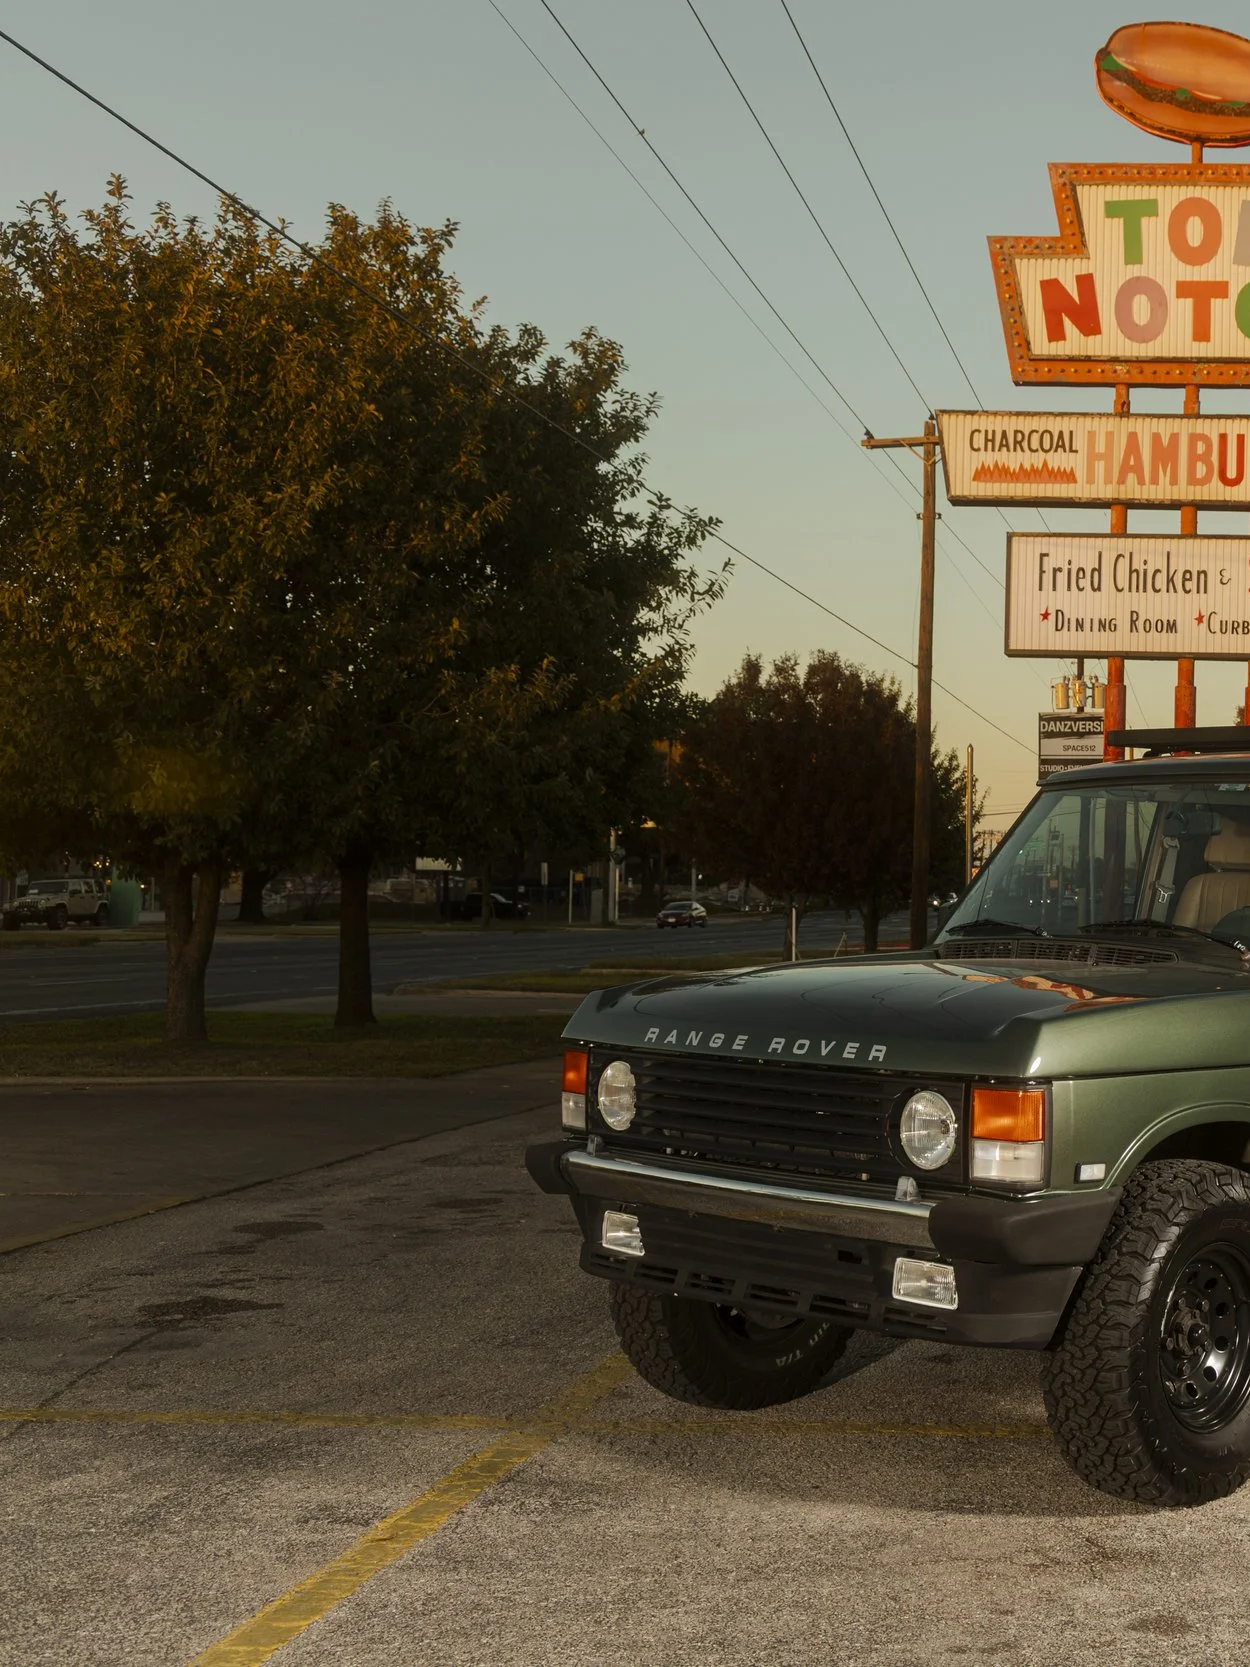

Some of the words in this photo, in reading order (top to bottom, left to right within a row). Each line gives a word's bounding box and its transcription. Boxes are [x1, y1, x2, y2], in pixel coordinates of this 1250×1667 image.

[969, 428, 1079, 454] CHARCOAL
[1038, 550, 1102, 592] Fried
[1113, 550, 1208, 594] Chicken
[1219, 568, 1232, 586] &
[1054, 609, 1117, 633] DINING
[1129, 610, 1178, 634] ROOM
[1207, 611, 1250, 635] CURB
[1062, 744, 1096, 752] SPACE512
[644, 1027, 749, 1050] RANGE
[767, 1037, 888, 1062] ROVER
